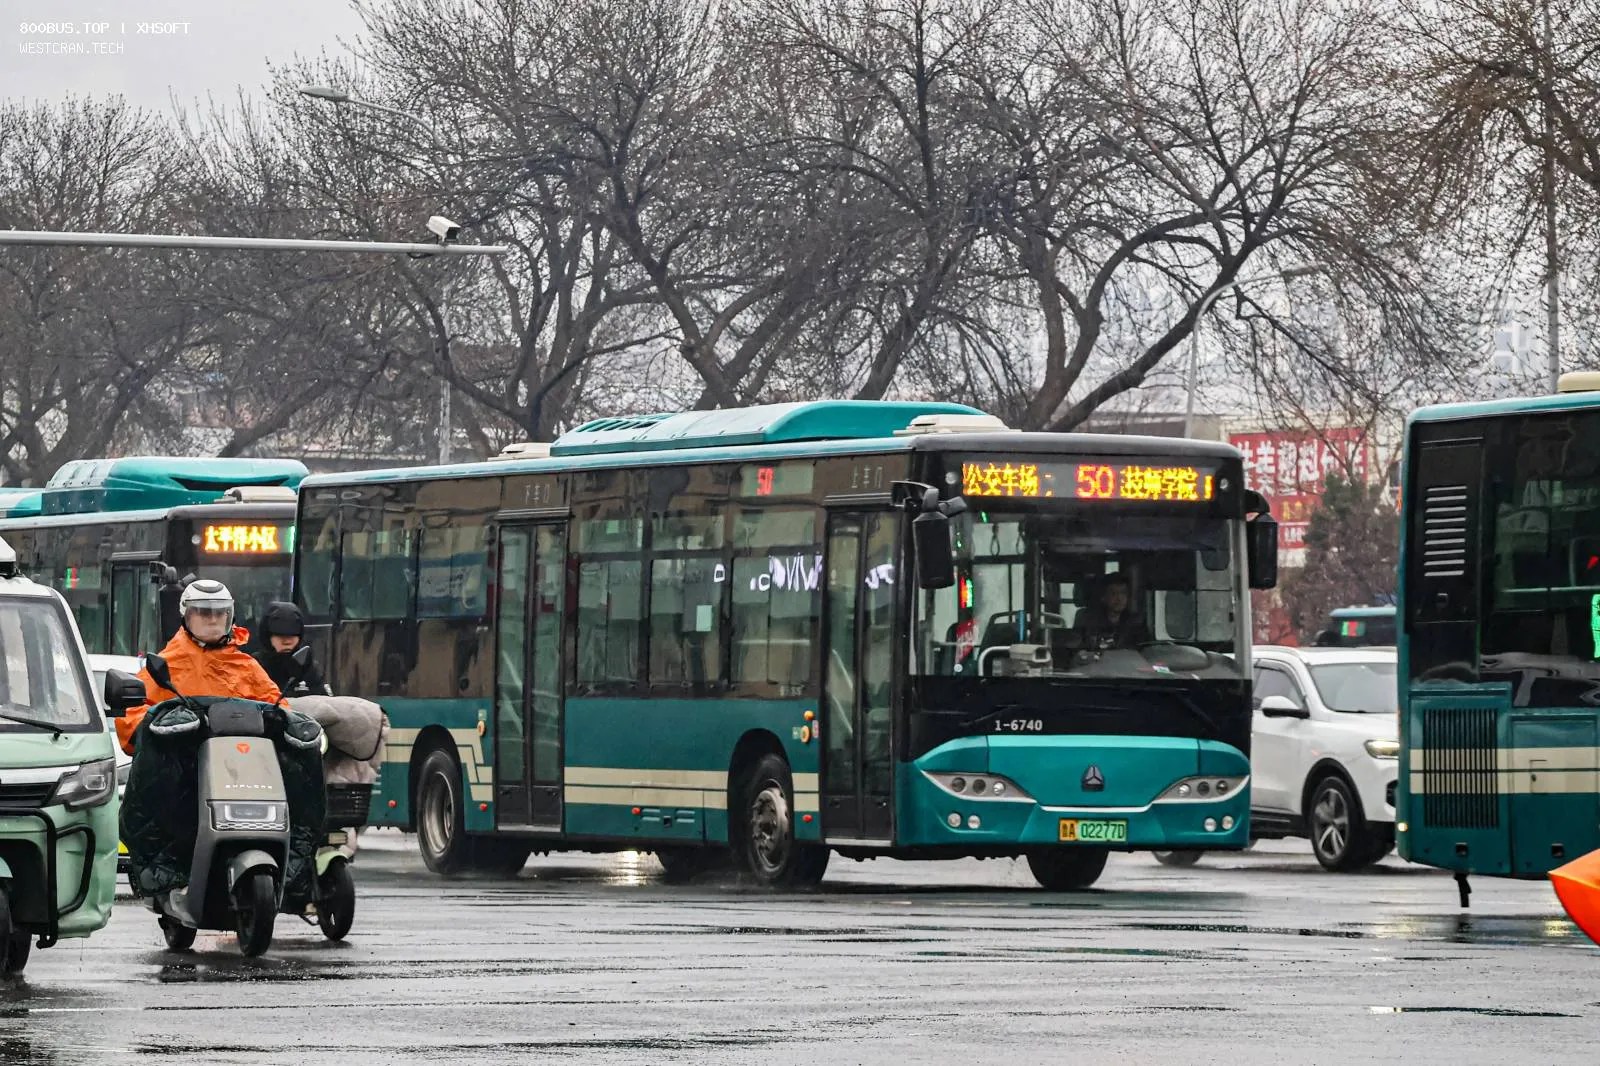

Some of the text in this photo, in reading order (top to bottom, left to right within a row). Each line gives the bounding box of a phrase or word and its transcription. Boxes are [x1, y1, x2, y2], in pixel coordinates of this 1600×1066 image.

[1076, 464, 1116, 498] 50
[1120, 465, 1200, 500] 技师学院
[994, 719, 1043, 731] 1-6740
